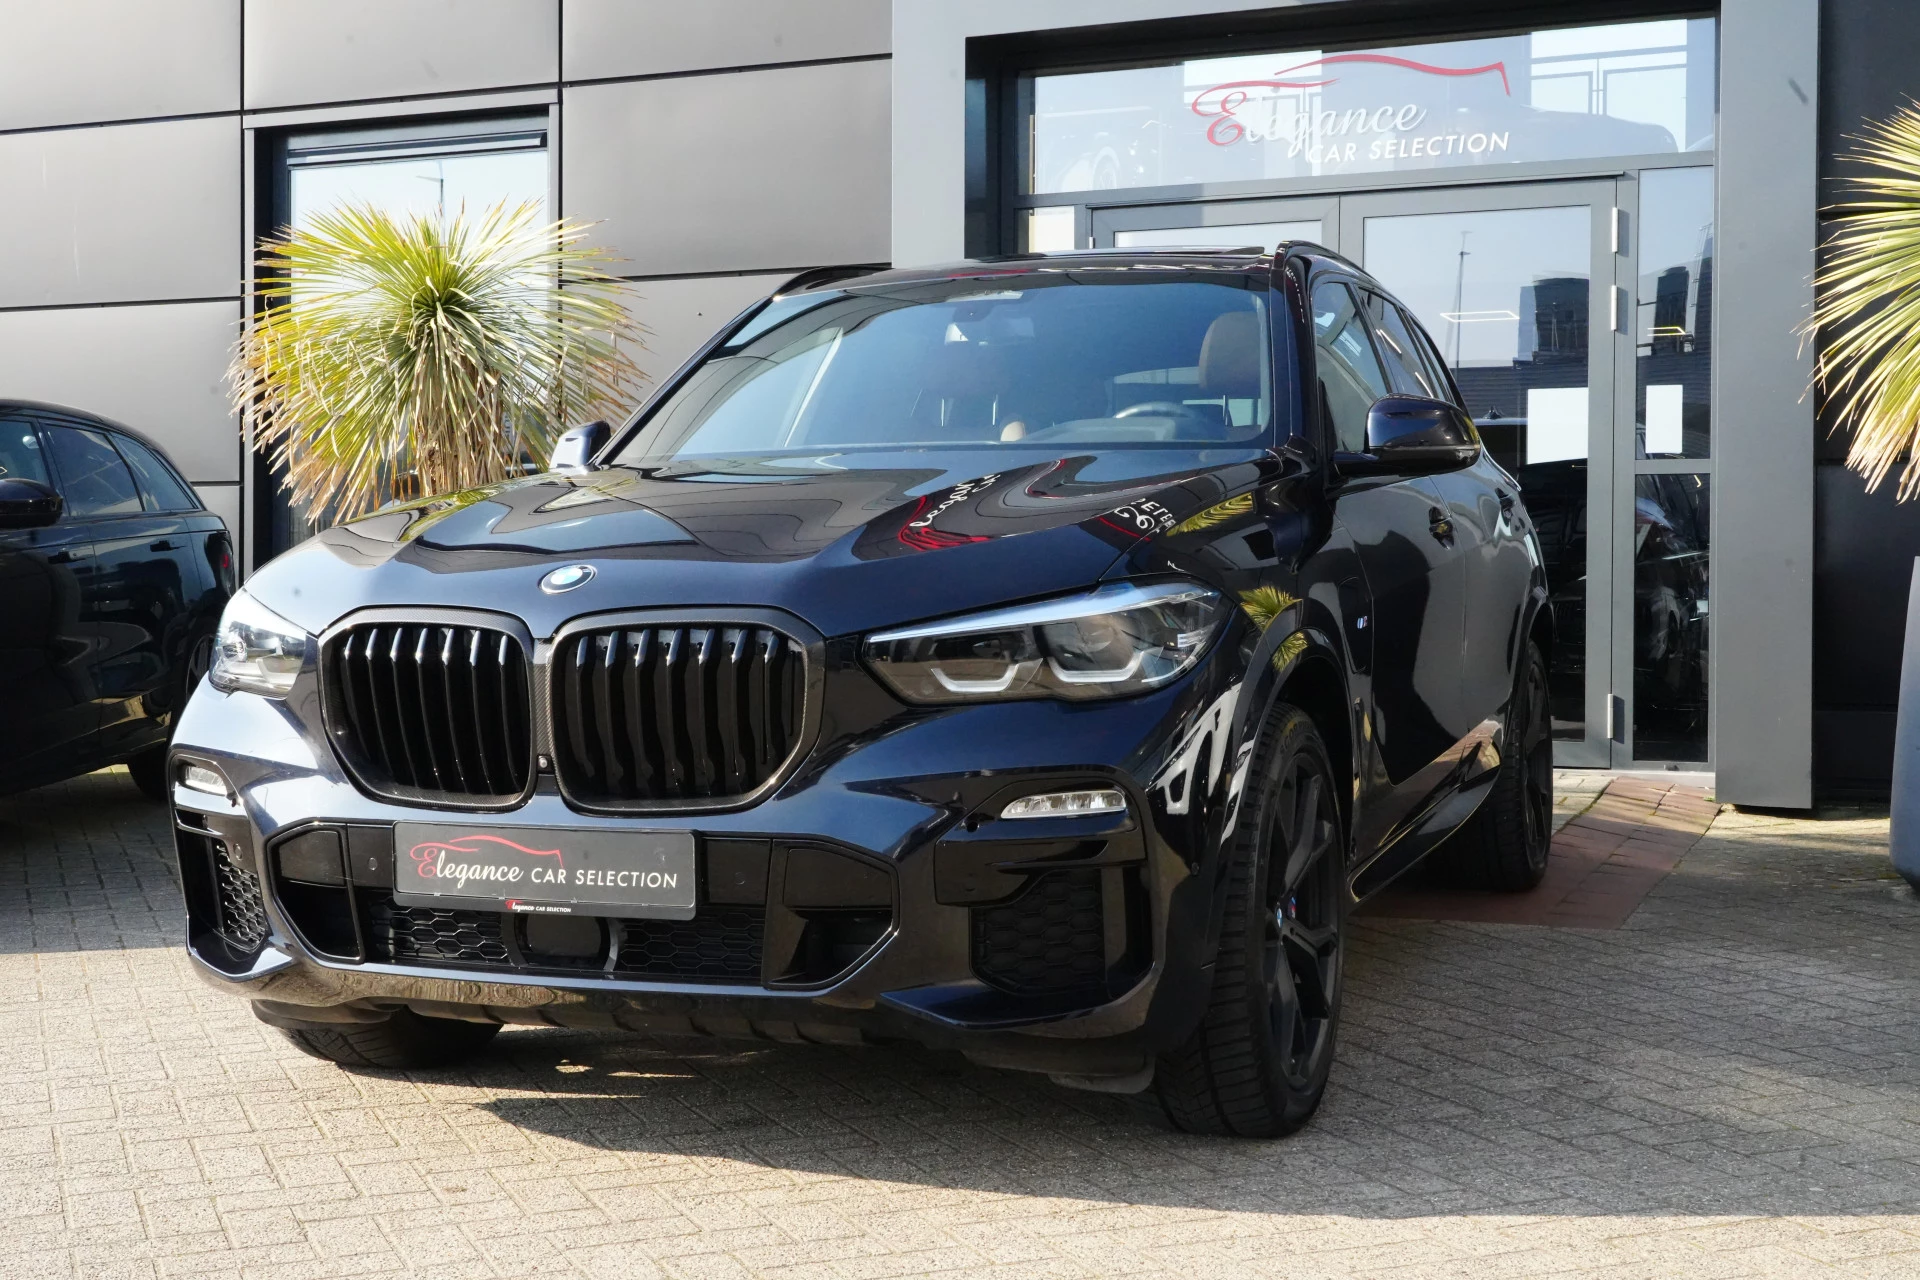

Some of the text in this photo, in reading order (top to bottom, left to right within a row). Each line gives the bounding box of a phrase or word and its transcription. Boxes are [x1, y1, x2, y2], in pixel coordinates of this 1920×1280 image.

[1308, 131, 1510, 164] CAR SELECTION
[410, 842, 678, 889] Elegance CAR SELECTION
